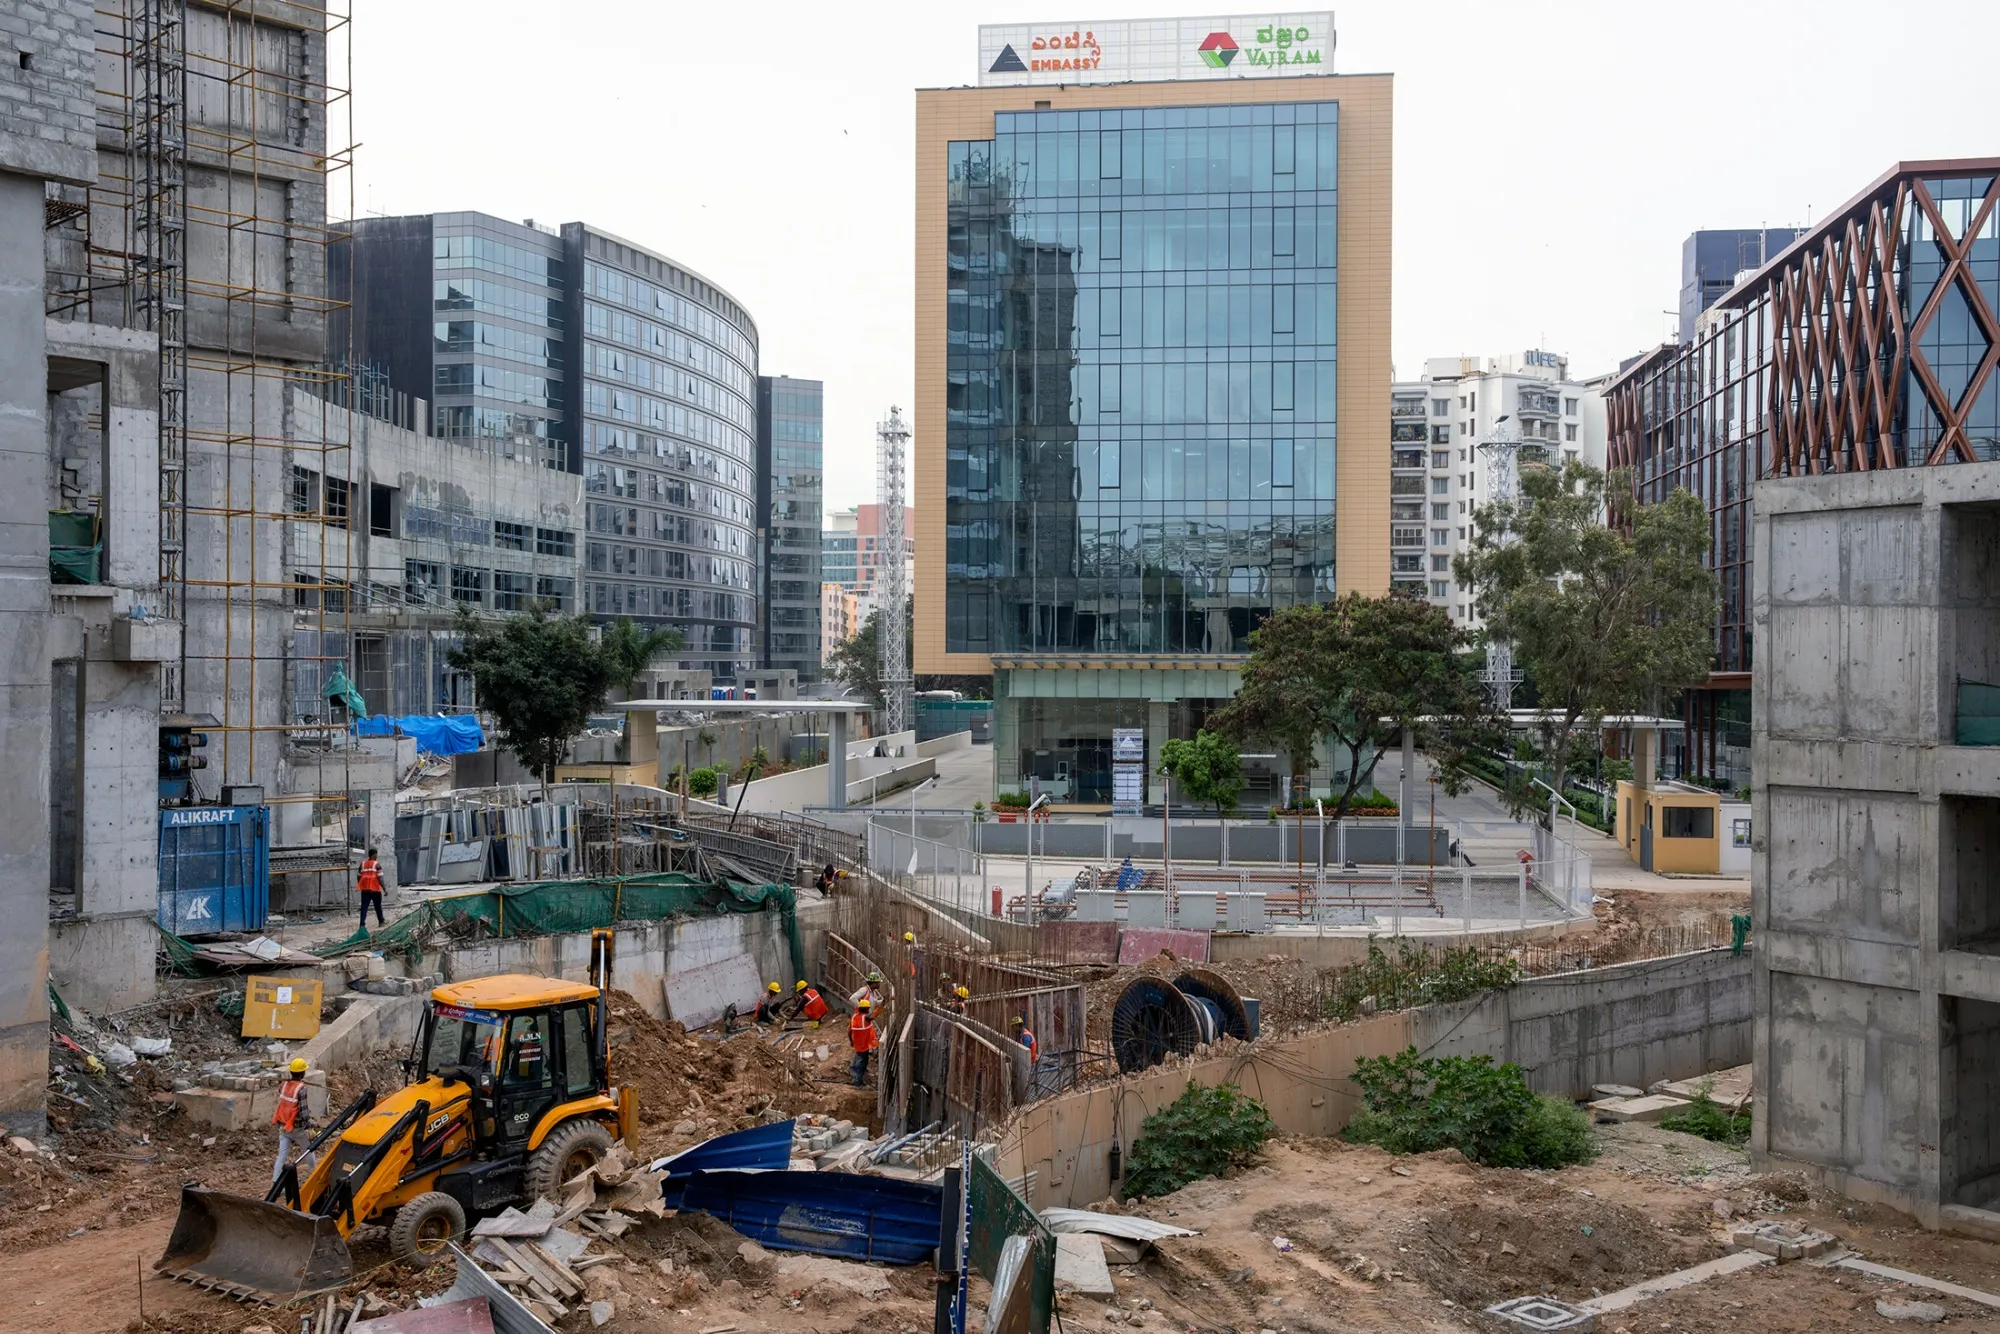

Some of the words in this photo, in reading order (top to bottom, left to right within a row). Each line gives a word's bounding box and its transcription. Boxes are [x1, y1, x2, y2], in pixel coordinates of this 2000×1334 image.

[1031, 57, 1101, 71] EMBASSY
[1244, 48, 1321, 69] VAJRAM
[171, 809, 235, 825] ALIKRAFT
[427, 1113, 450, 1134] JCB
[513, 1113, 530, 1121] eco
